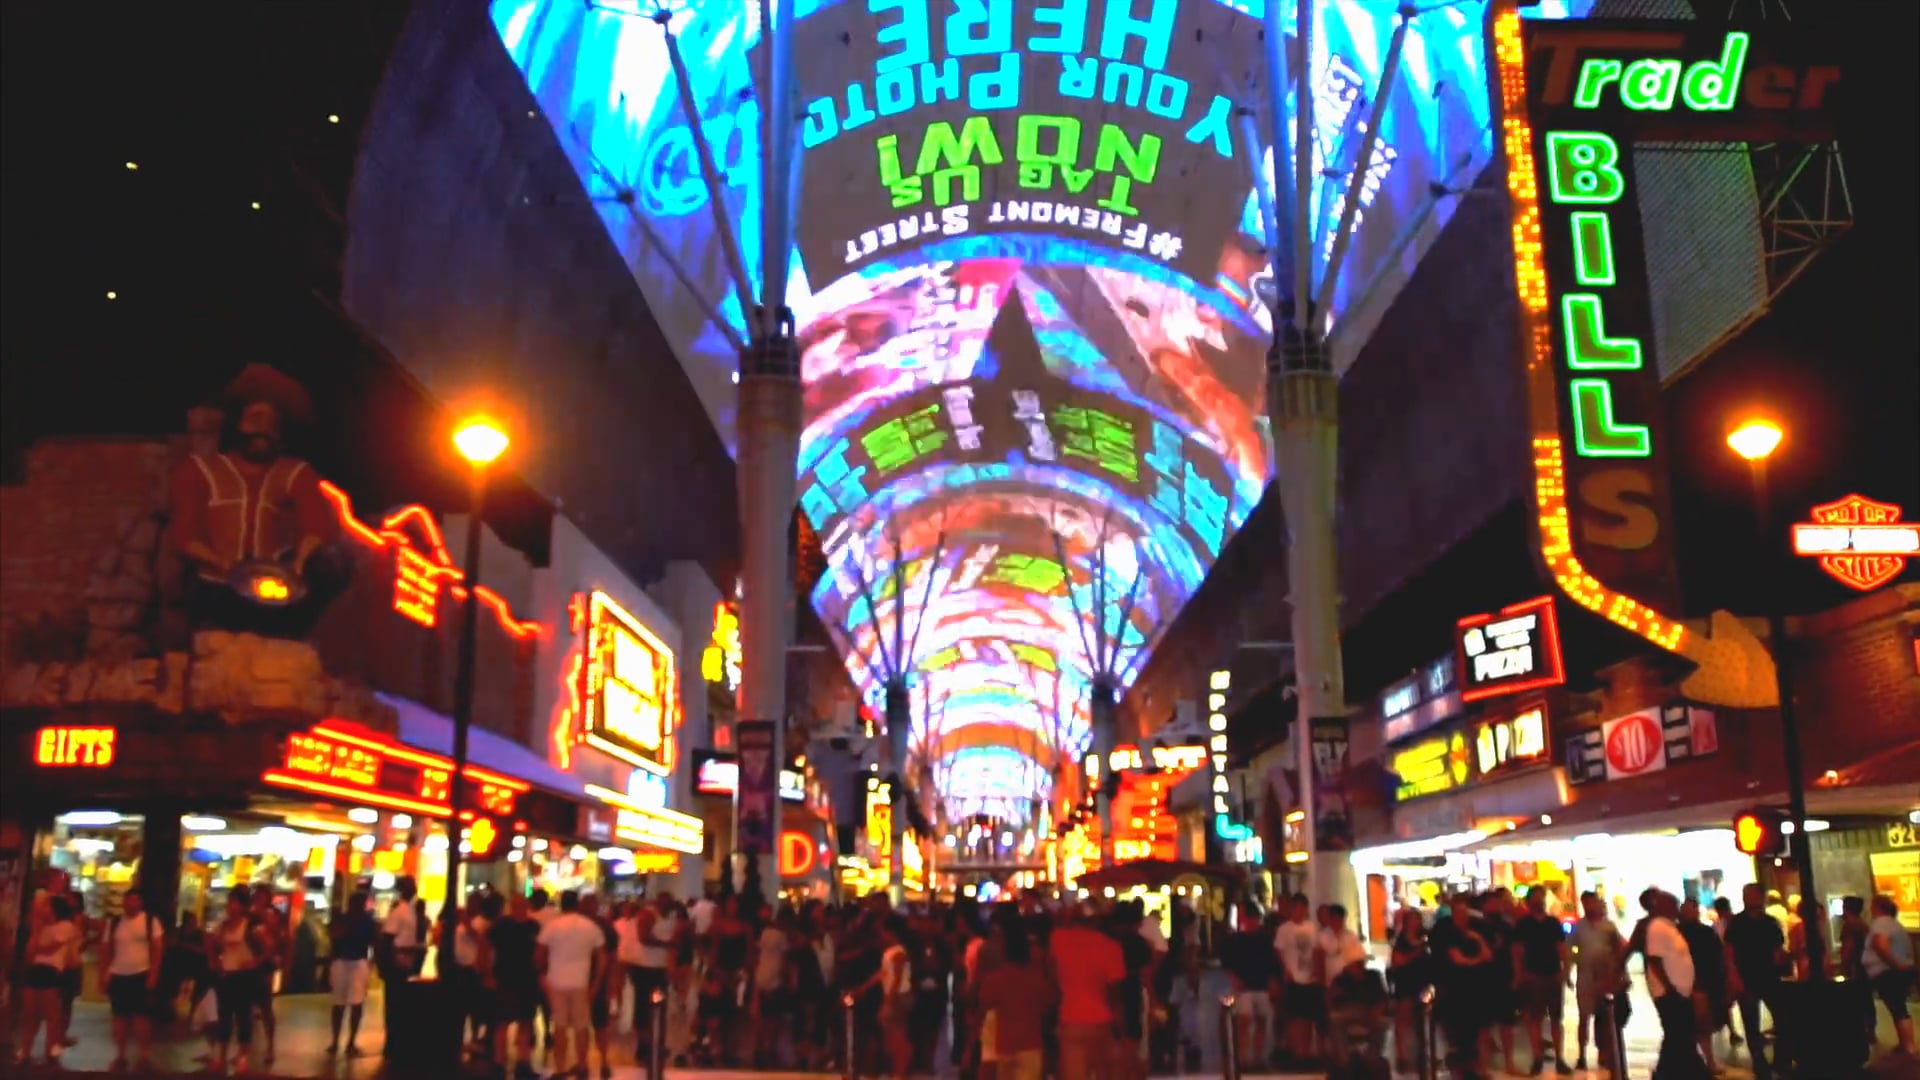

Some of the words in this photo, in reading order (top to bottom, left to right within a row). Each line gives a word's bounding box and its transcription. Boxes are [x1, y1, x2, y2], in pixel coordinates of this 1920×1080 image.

[870, 0, 1178, 73] HERE
[802, 52, 1020, 148] PHOTO
[1059, 56, 1233, 157] YOUR
[877, 115, 1161, 184] NOW!
[890, 165, 980, 207] US
[1018, 162, 1138, 216] TAG
[844, 205, 969, 263] STREET
[988, 201, 1182, 261] #FREMONT
[1546, 131, 1658, 550] BILLS
[1826, 502, 1887, 523] MOTOR
[38, 728, 115, 765] GIFTS
[778, 830, 817, 876] D
